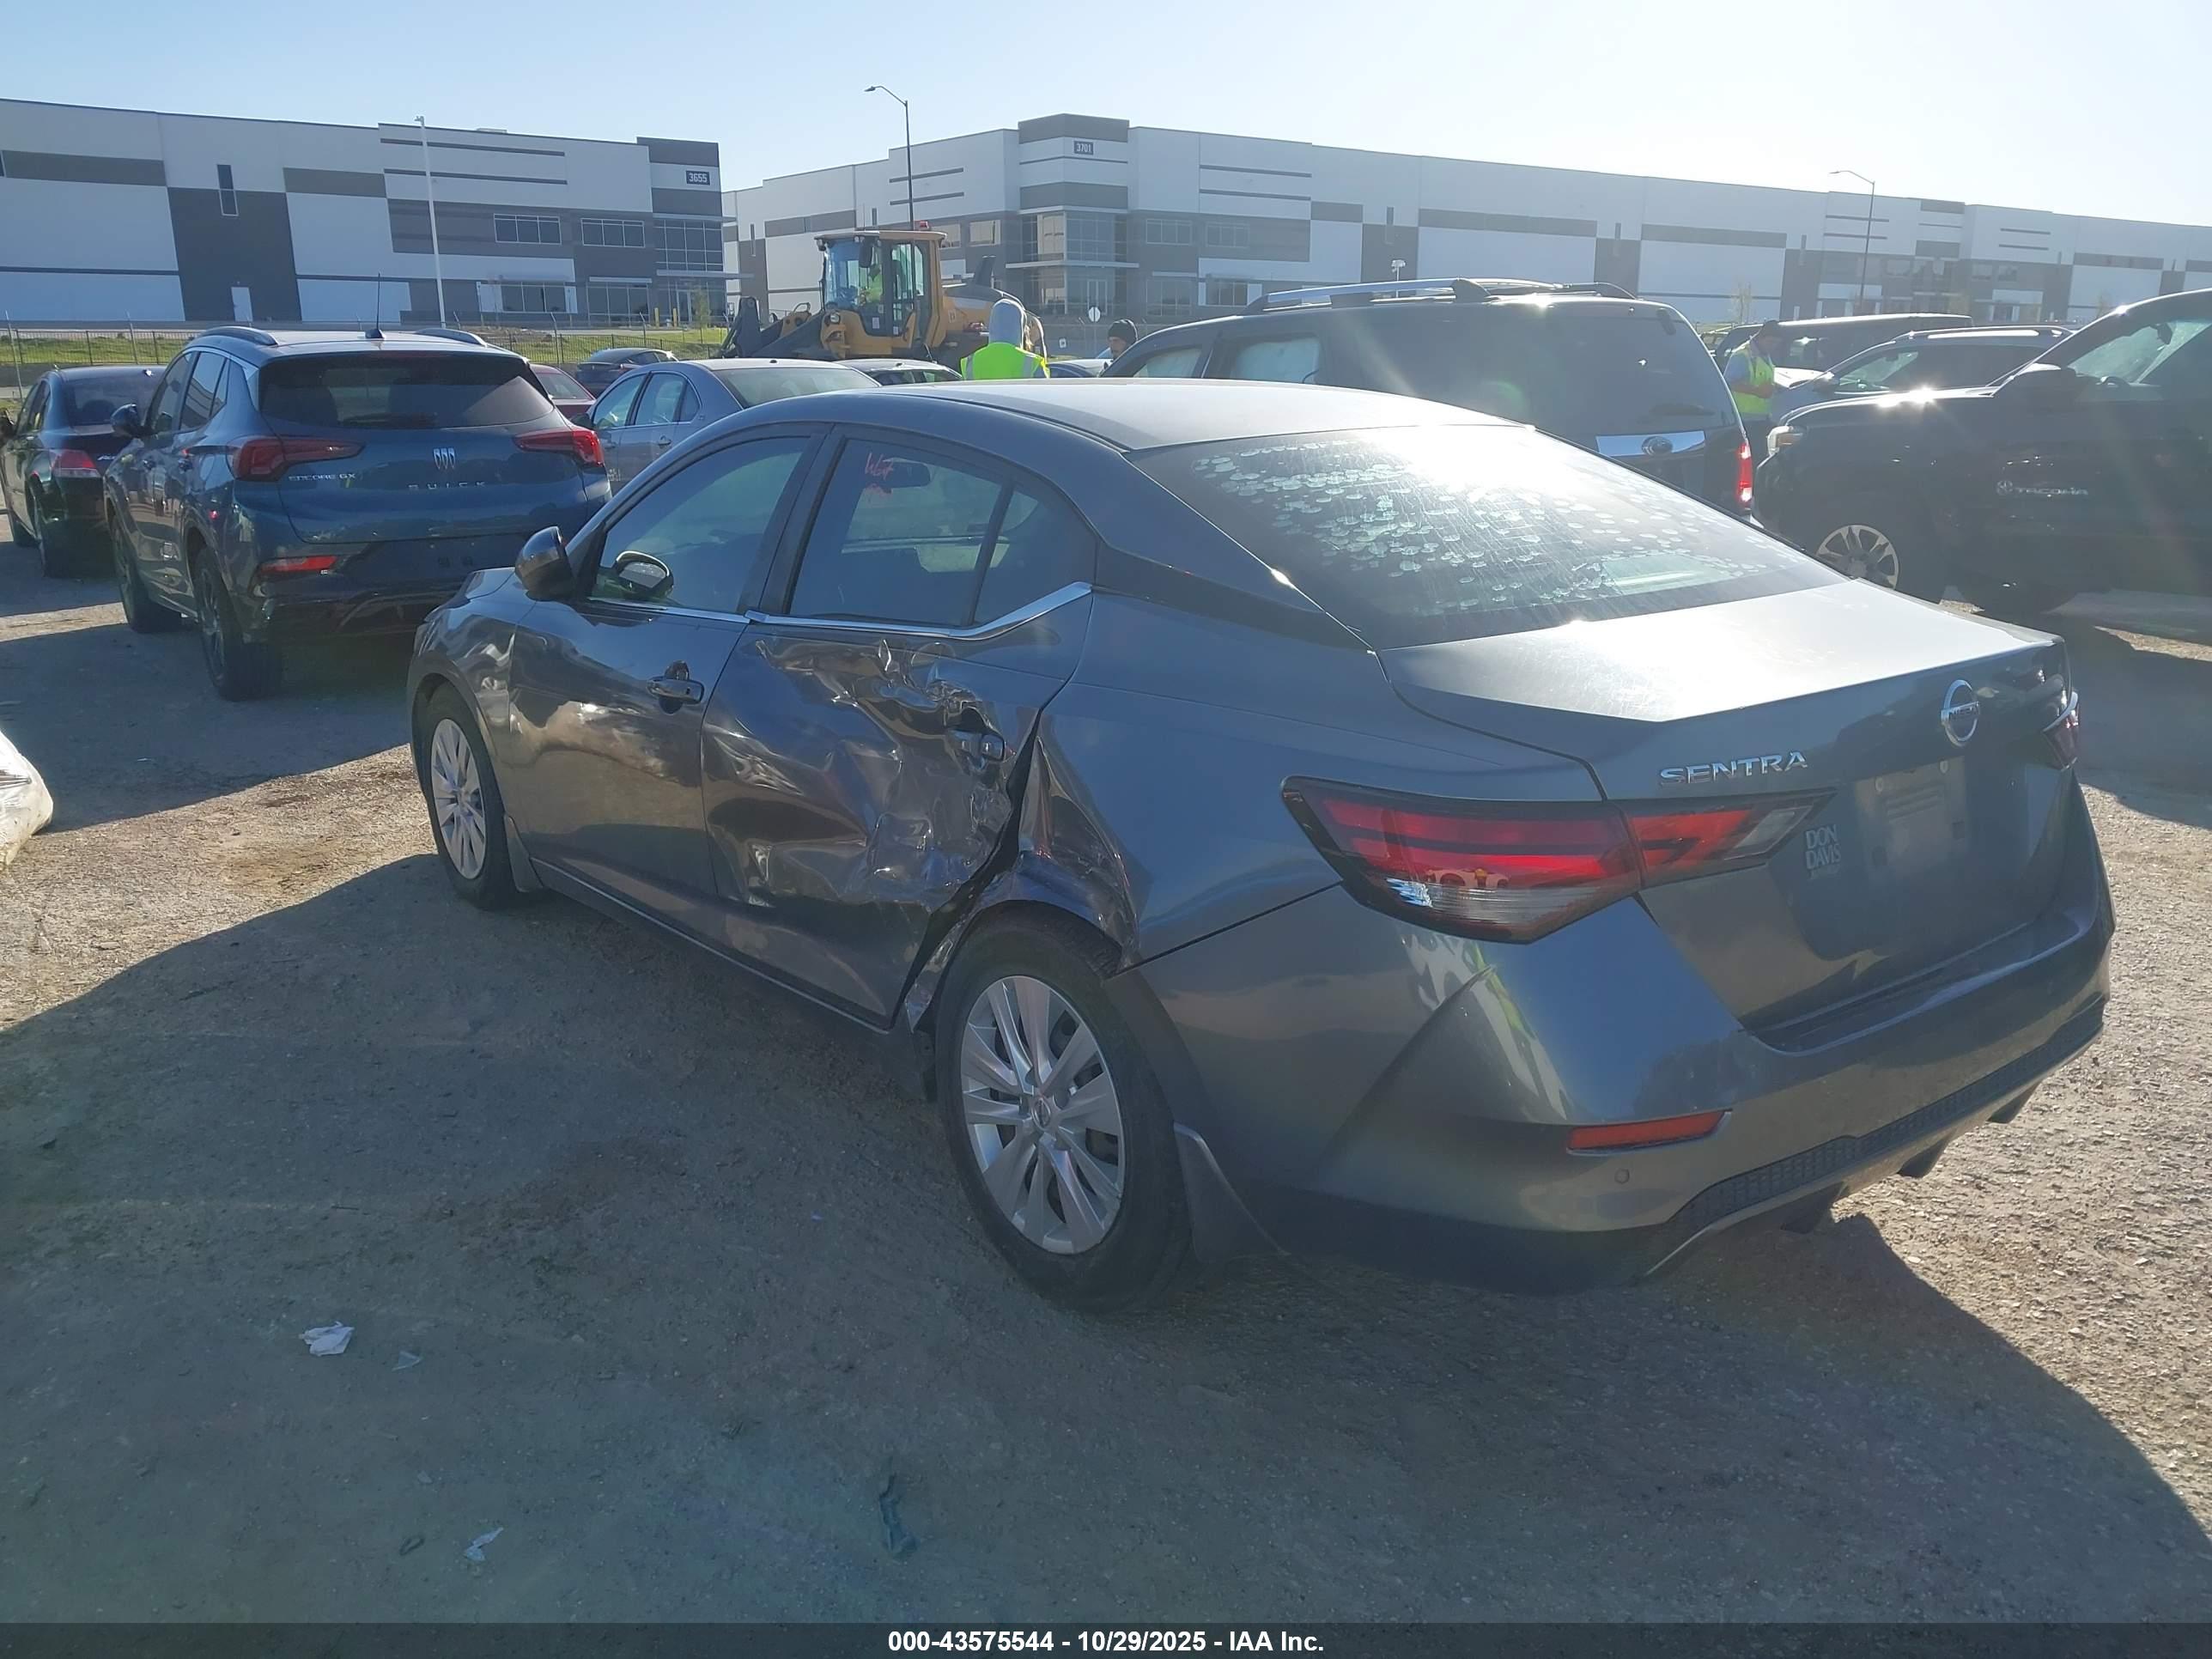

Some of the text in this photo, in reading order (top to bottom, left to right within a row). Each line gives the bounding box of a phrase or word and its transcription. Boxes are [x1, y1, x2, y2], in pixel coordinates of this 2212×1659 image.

[1076, 143, 1091, 153] 3701
[689, 173, 708, 183] 3655
[408, 481, 486, 490] BUICK
[1660, 750, 1808, 786] SENTRA
[1806, 823, 1838, 849] DON
[1805, 844, 1842, 869] DAVIS
